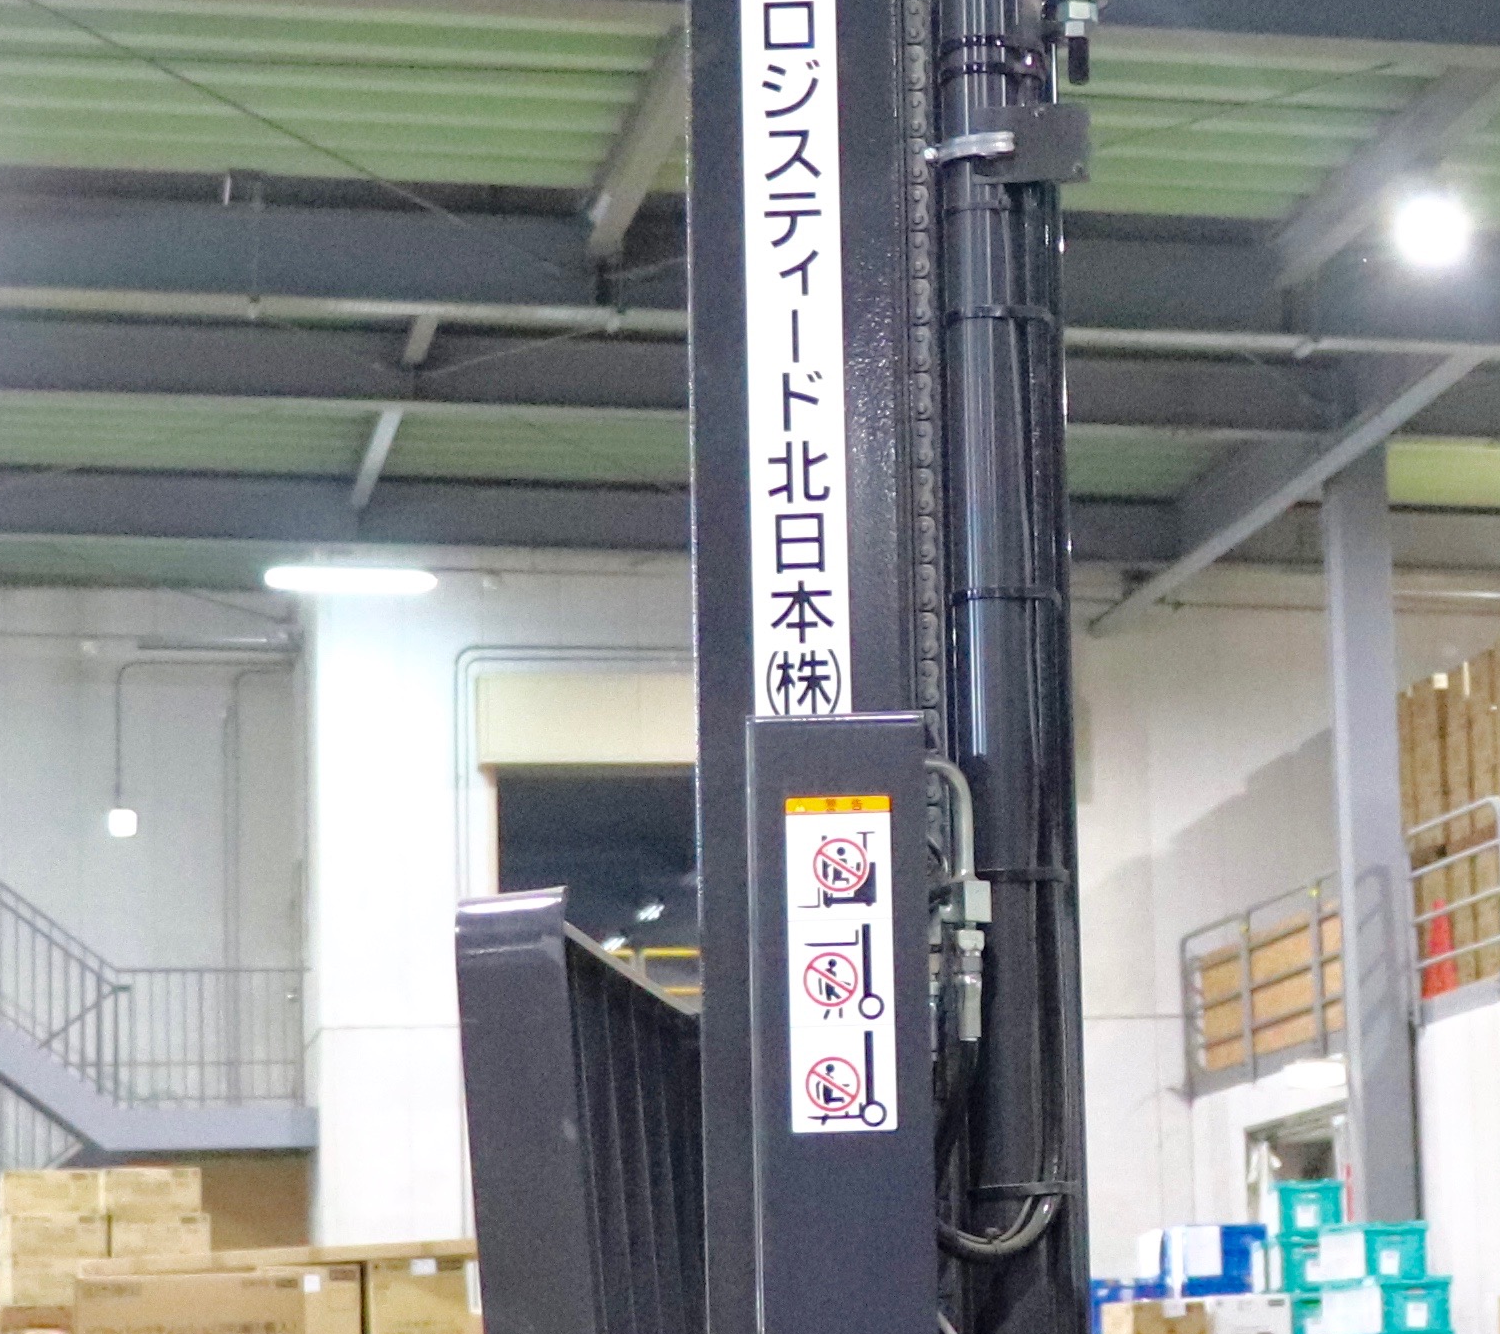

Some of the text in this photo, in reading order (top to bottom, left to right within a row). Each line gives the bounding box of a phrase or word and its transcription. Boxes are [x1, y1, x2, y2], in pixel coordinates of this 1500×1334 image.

[760, 0, 842, 714] ロジスティード北日本(株)
